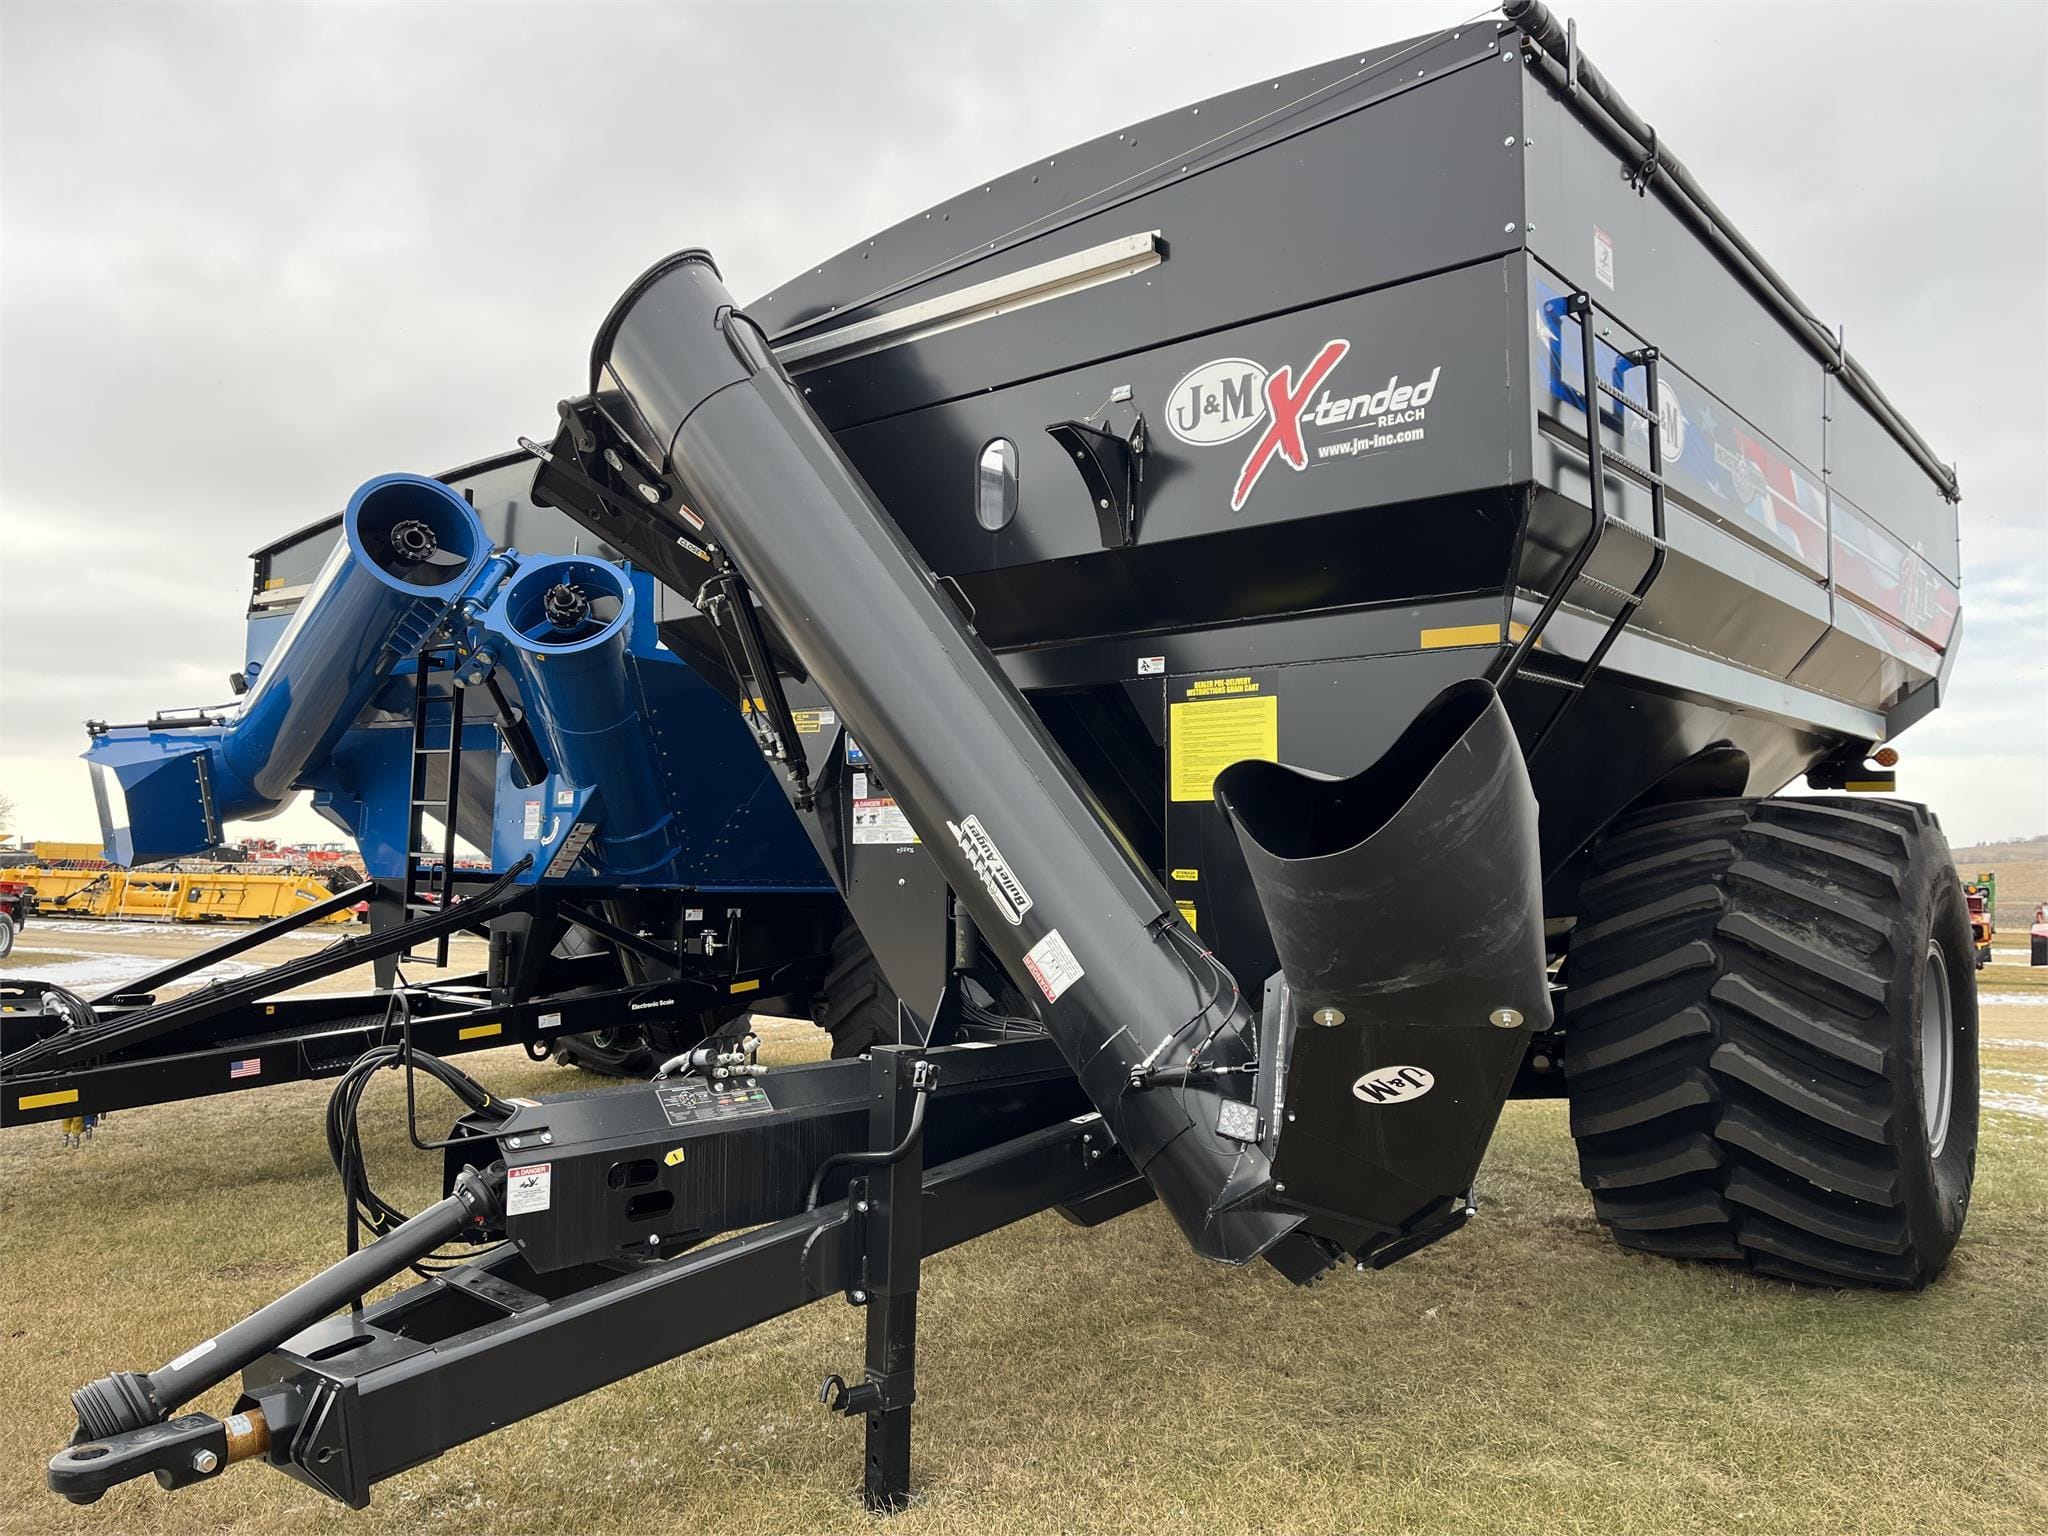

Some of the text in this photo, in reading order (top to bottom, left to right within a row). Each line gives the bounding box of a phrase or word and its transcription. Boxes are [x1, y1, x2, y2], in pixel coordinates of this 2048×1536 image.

[1176, 372, 1255, 431] J&M
[1378, 407, 1425, 428] REACH
[527, 443, 546, 457] OPEN
[1318, 428, 1425, 458] www.jm-inc.com
[967, 824, 997, 861] Auger
[995, 866, 1026, 907] Bullet
[1025, 955, 1050, 992] DANGER
[631, 998, 674, 1010] Electronic Scale
[1357, 1068, 1426, 1103] J&M
[520, 1166, 546, 1176] DANGER
